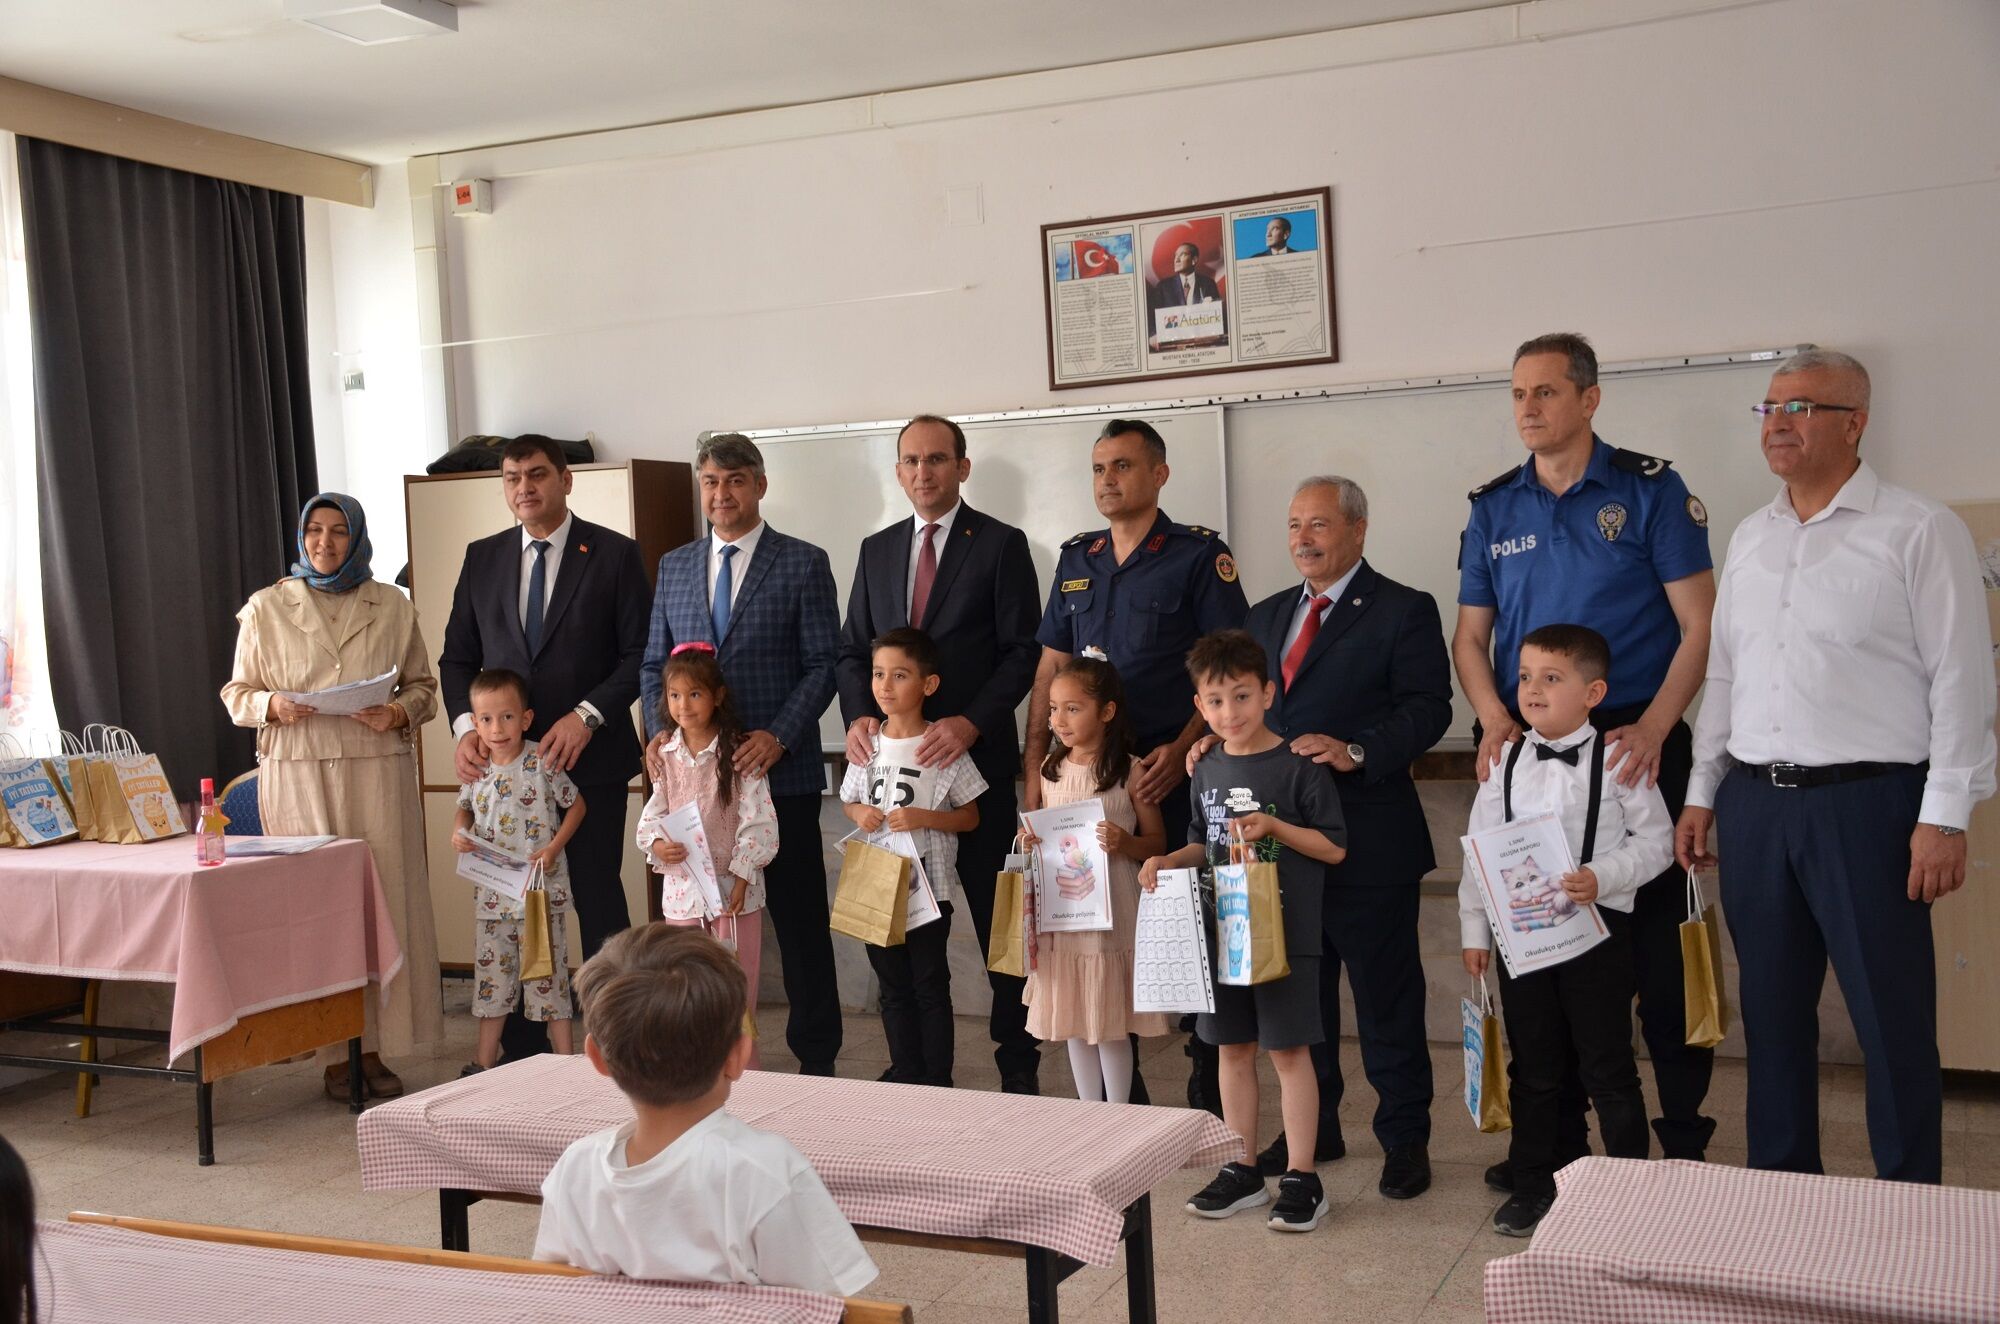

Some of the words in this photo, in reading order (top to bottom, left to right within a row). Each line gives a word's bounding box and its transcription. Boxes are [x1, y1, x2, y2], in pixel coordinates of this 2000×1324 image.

[1180, 309, 1221, 328] Atatürk
[1209, 805, 1226, 824] you
[1524, 944, 1557, 959] Okudukça
